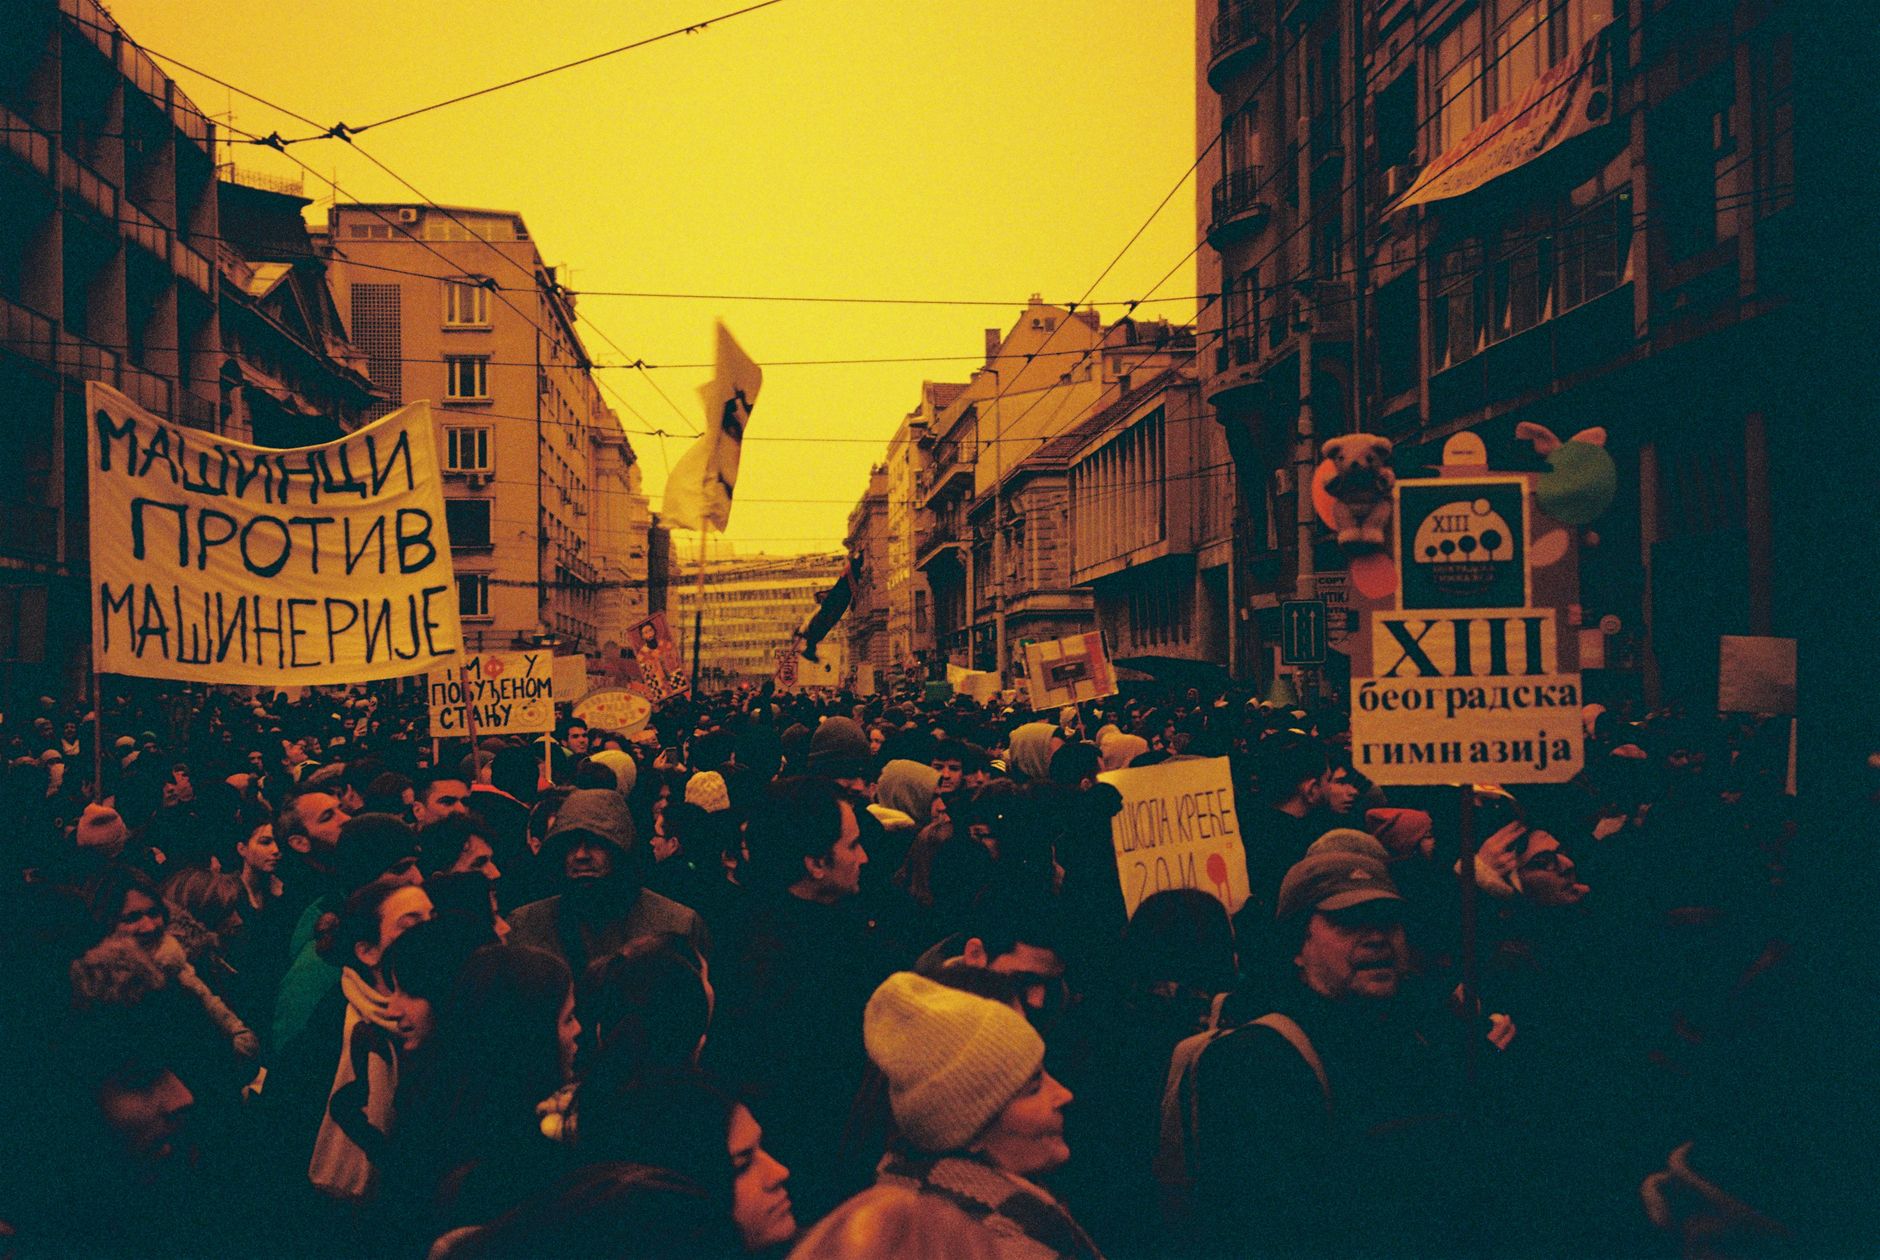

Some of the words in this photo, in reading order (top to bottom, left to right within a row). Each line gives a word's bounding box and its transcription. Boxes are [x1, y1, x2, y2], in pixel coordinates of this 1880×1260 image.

[95, 408, 415, 504] МАШИНЦИ
[131, 497, 437, 578] ПРОТИВ
[99, 583, 457, 670] МАШИНЕРИЈЕ
[1382, 616, 1549, 679] XIII
[439, 703, 513, 730] СТАЊУ
[1358, 680, 1579, 719] београдска
[1361, 728, 1573, 771] гимназија
[1174, 787, 1234, 844] КРЕЋЕ
